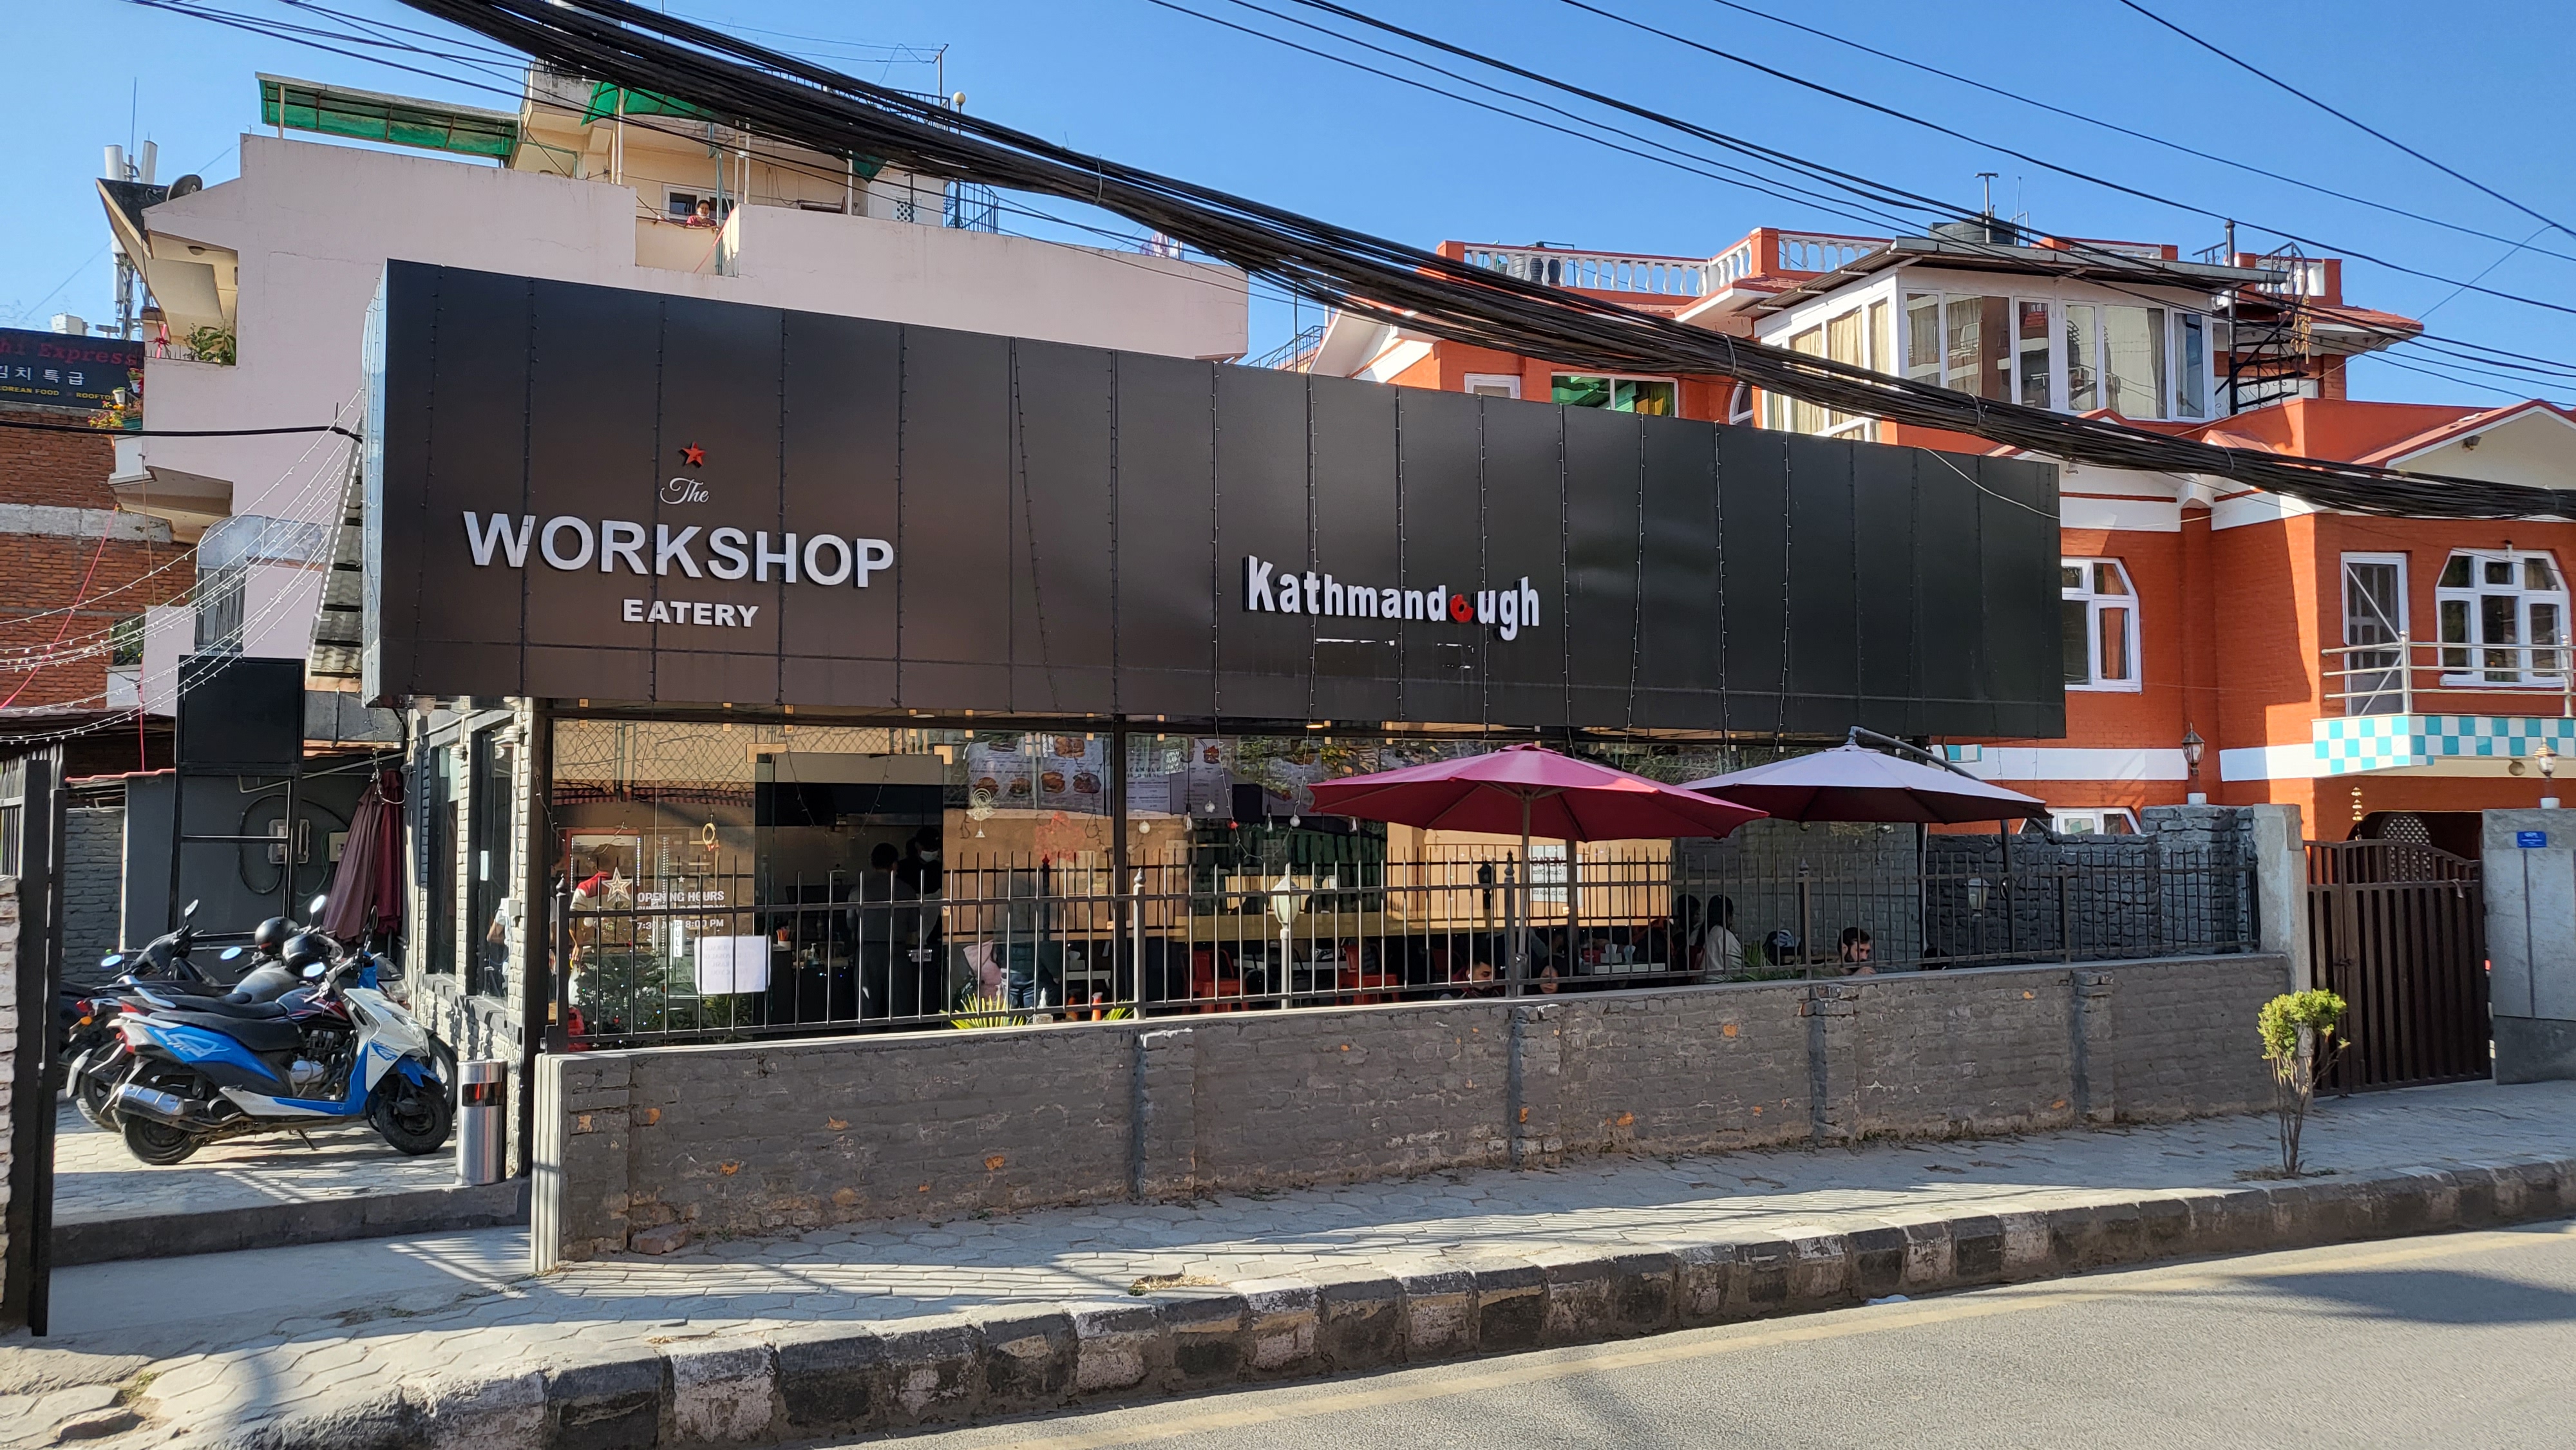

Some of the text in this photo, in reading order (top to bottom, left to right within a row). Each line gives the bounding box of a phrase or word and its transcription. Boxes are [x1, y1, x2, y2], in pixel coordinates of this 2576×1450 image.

[38, 343, 138, 366] Express
[43, 369, 84, 386] 특급
[659, 477, 709, 504] The
[462, 511, 895, 588] WORKSHOP
[1244, 554, 1540, 641] Kathmandough
[623, 599, 759, 627] EATERY
[637, 892, 685, 902] OPENNG
[710, 919, 724, 927] PM
